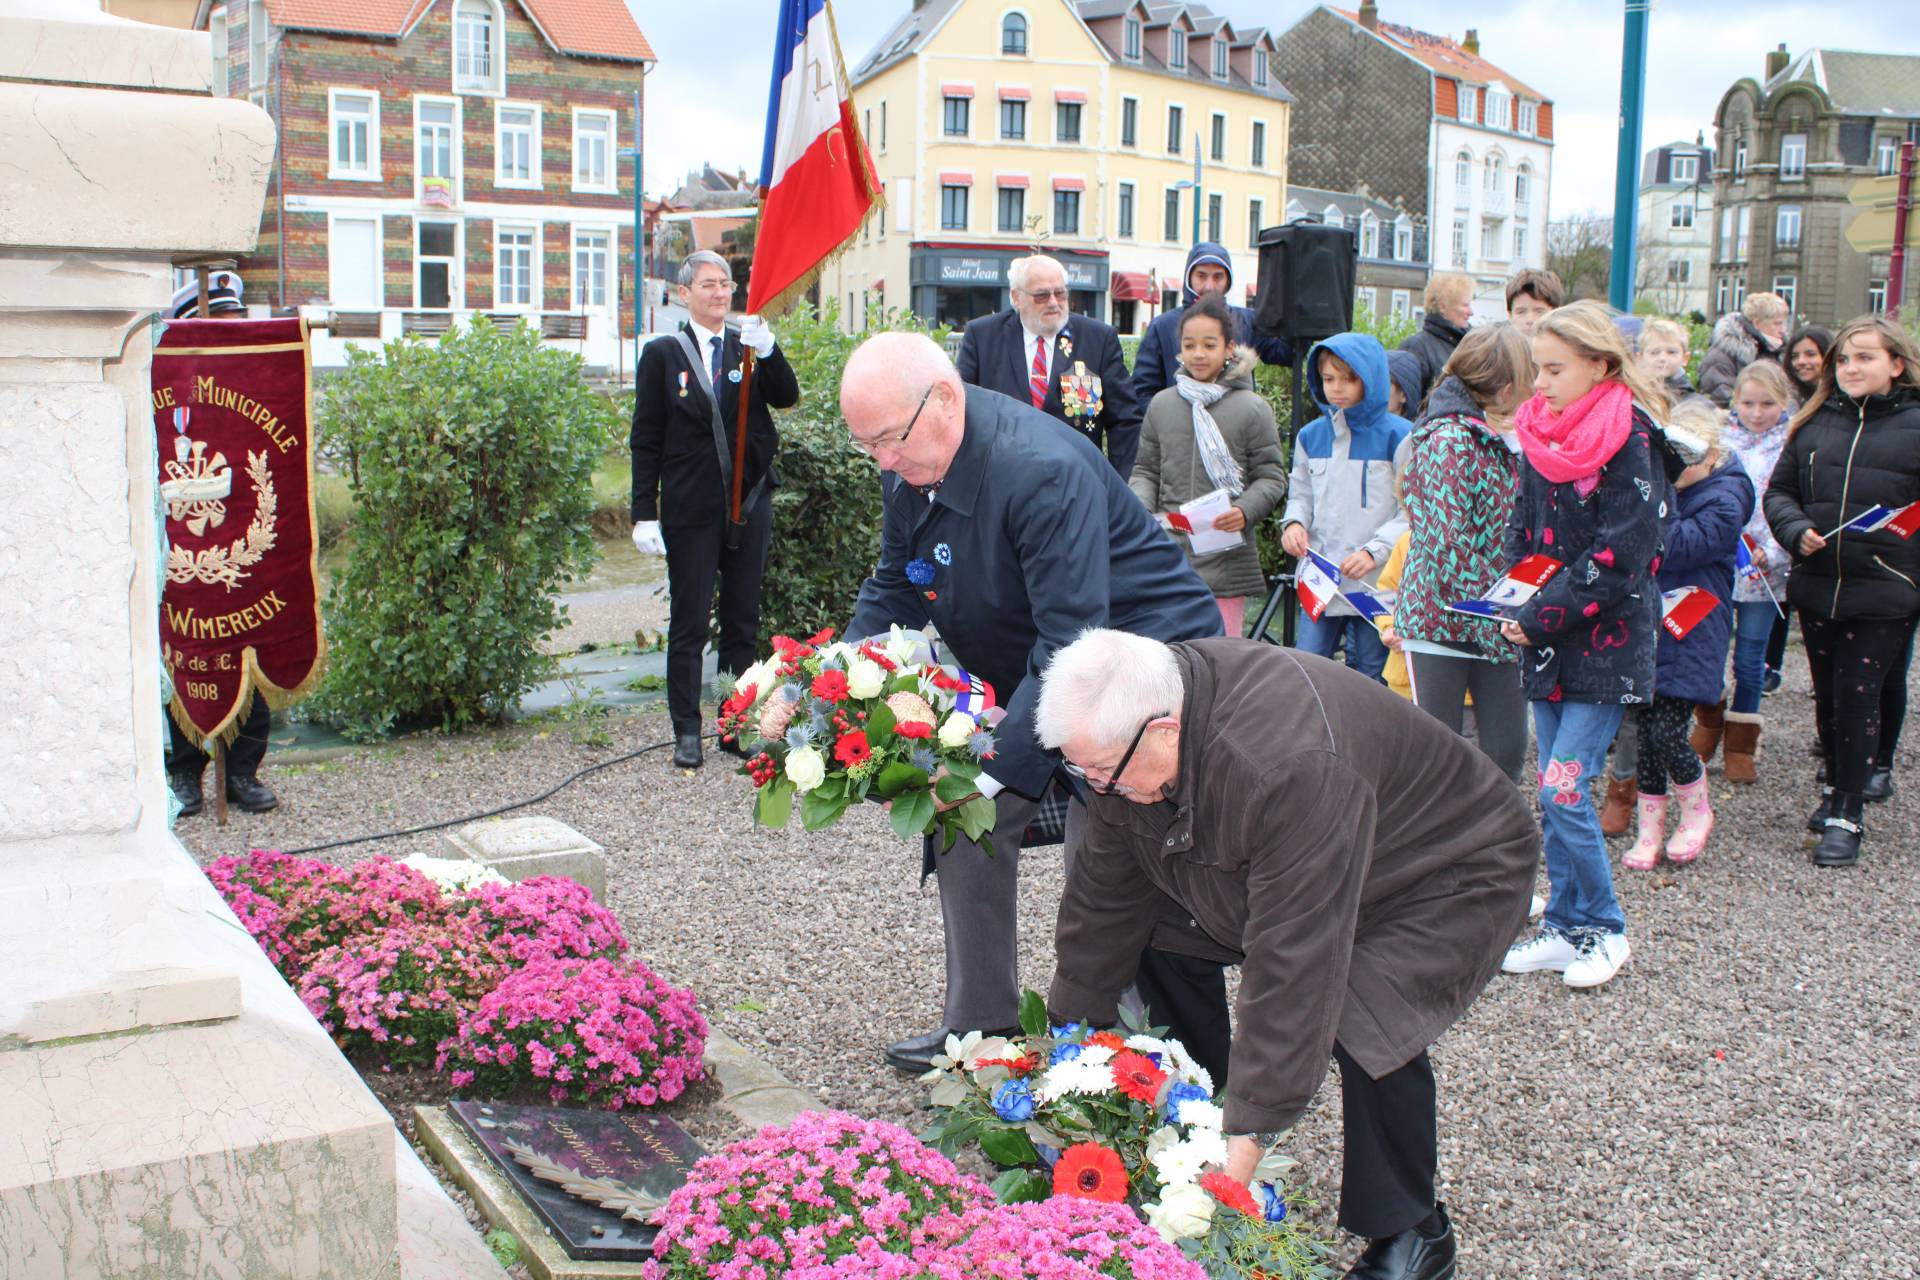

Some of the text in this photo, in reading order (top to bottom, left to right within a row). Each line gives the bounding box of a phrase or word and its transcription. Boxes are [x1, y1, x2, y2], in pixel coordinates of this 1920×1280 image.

[942, 265, 998, 280] Saint Jean
[197, 375, 299, 454] MUNICIPALE
[1536, 564, 1556, 585] 1918
[166, 590, 287, 640] WIMEREUX
[1665, 617, 1684, 635] 1918
[188, 656, 208, 672] de
[186, 681, 218, 700] 1908
